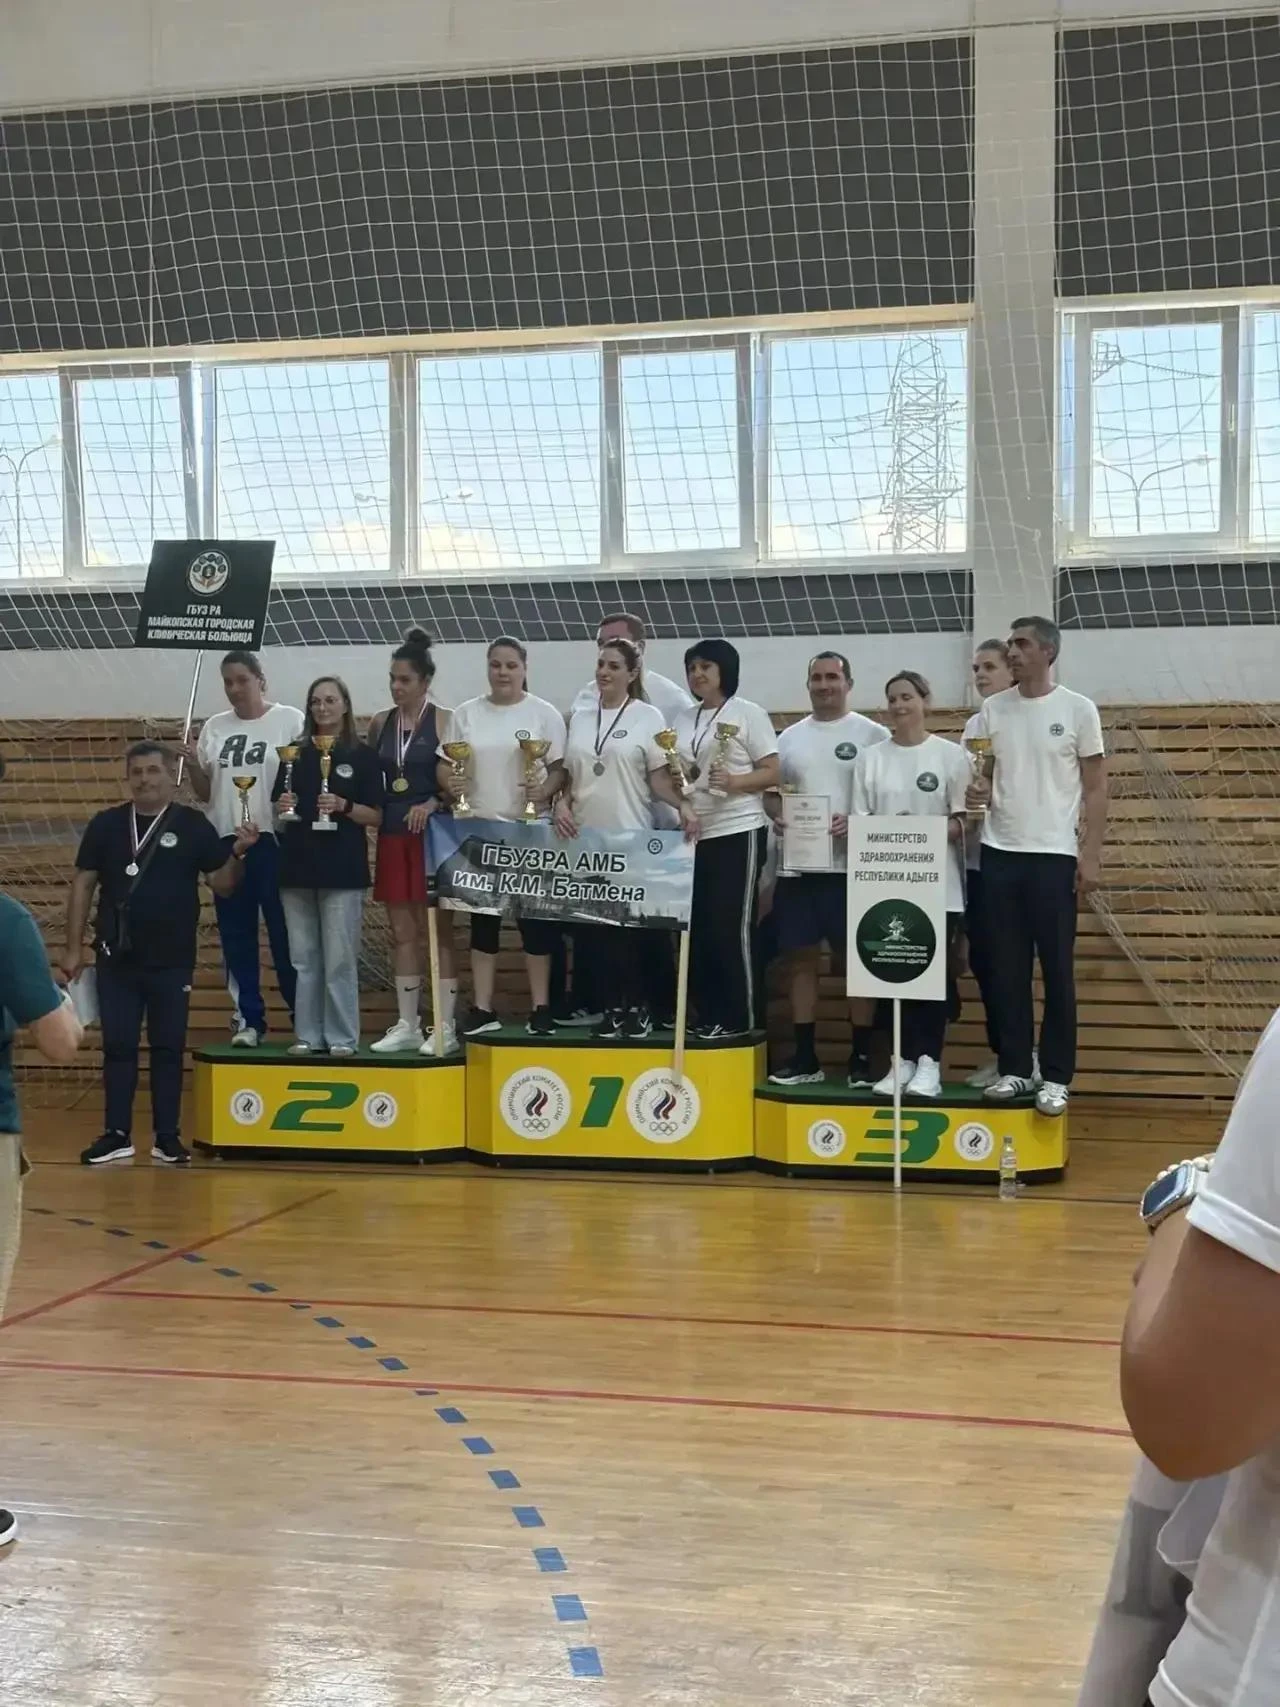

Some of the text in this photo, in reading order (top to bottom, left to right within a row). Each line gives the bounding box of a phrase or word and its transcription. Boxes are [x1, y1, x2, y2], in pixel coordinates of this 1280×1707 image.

[186, 604, 221, 616] ГБУЗ РА
[147, 614, 255, 630] МАЙКОПСКАЯ ГОРОДСКАЯ
[207, 631, 253, 643] БОЛЬНИЦА
[866, 833, 928, 843] МИНИСТЕРСТВО
[482, 843, 627, 873] ГБУЗРА АМБ
[859, 851, 935, 863] ЗДРАВООХРАНЕНИЯ
[854, 870, 939, 883] РЕСПУБЛИКИ АДЫГЕЯ
[452, 870, 647, 902] им. К.М. Батмена
[270, 1081, 360, 1132] 2
[580, 1076, 624, 1128] 1
[854, 1110, 949, 1163] 3
